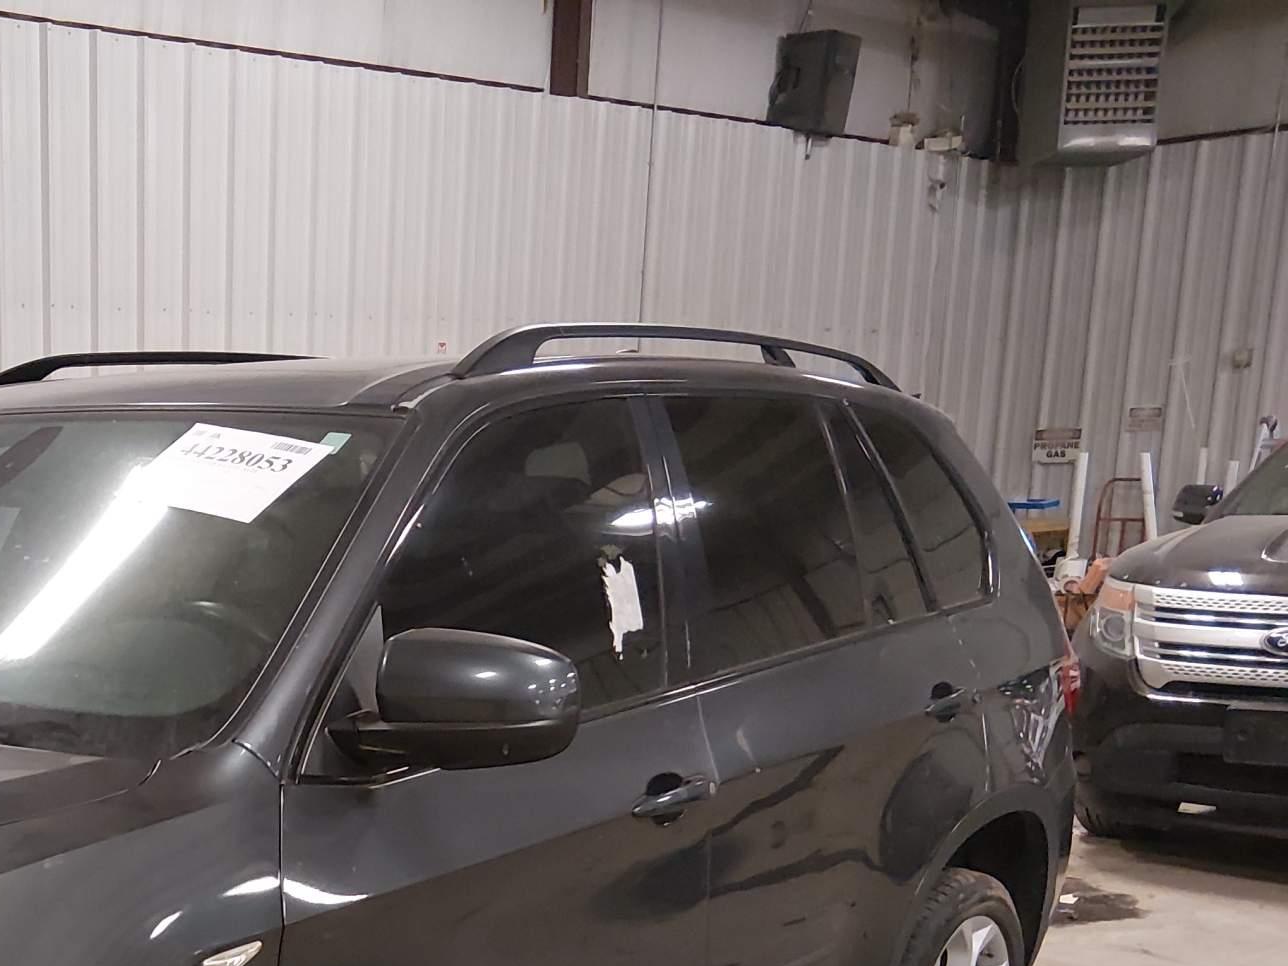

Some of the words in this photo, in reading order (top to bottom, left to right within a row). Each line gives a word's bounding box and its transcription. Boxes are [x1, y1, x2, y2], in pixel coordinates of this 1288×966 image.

[1034, 441, 1079, 450] PROPANE
[181, 443, 293, 473] 44228053
[1046, 450, 1066, 458] GAS
